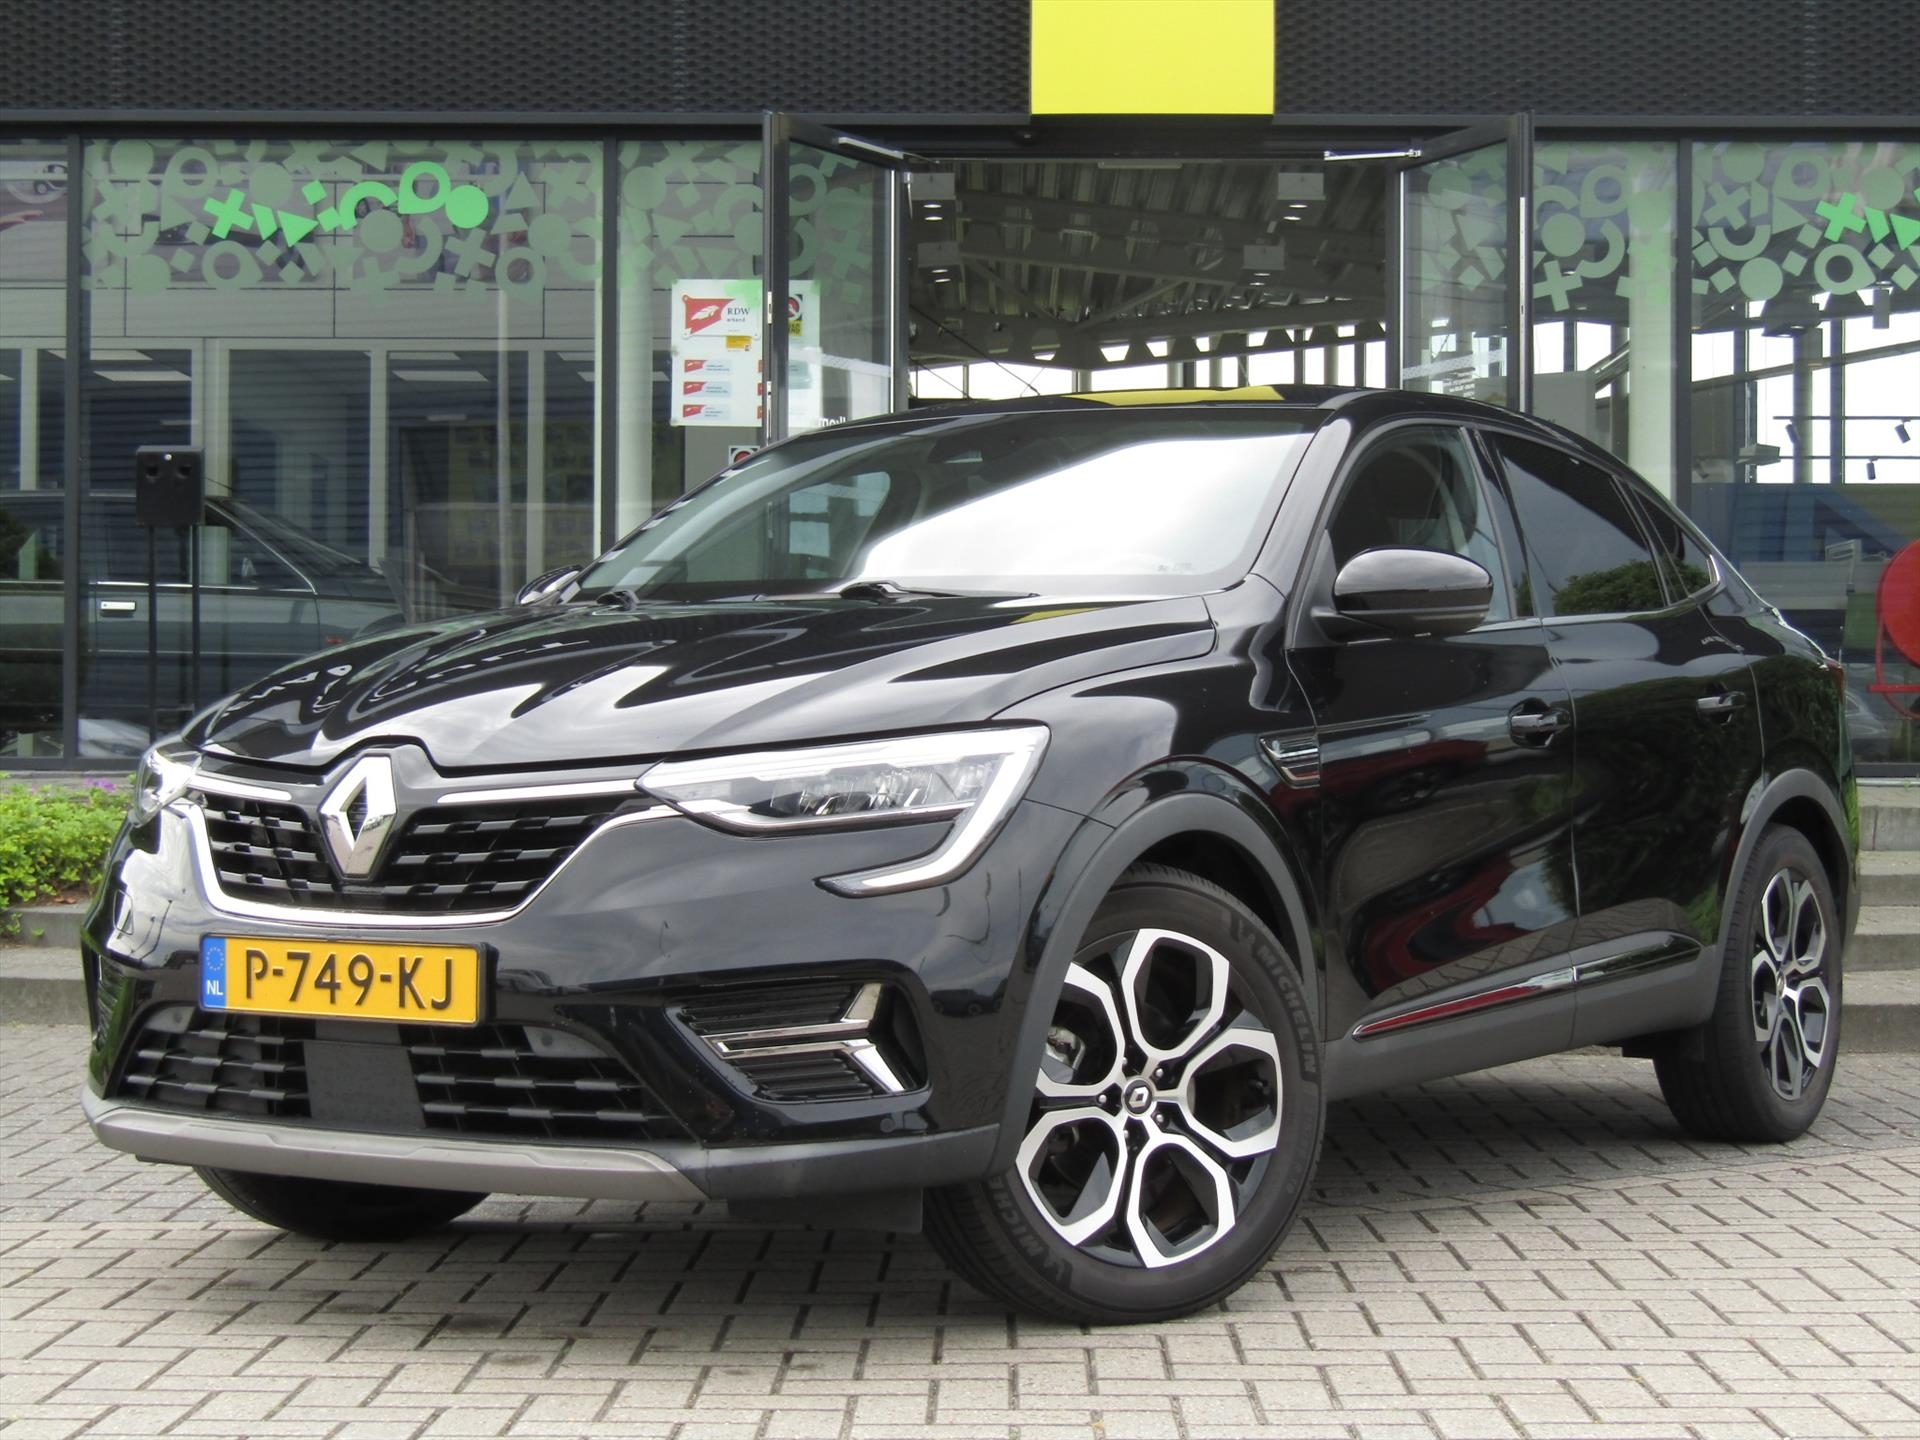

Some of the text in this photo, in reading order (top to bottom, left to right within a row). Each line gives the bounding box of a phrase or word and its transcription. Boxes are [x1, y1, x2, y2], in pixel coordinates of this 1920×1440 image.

[727, 307, 750, 315] RDW
[206, 949, 453, 1010] NL P-749-KJ
[1257, 944, 1317, 1074] MICHELIN
[988, 1175, 1045, 1257] MICHE
